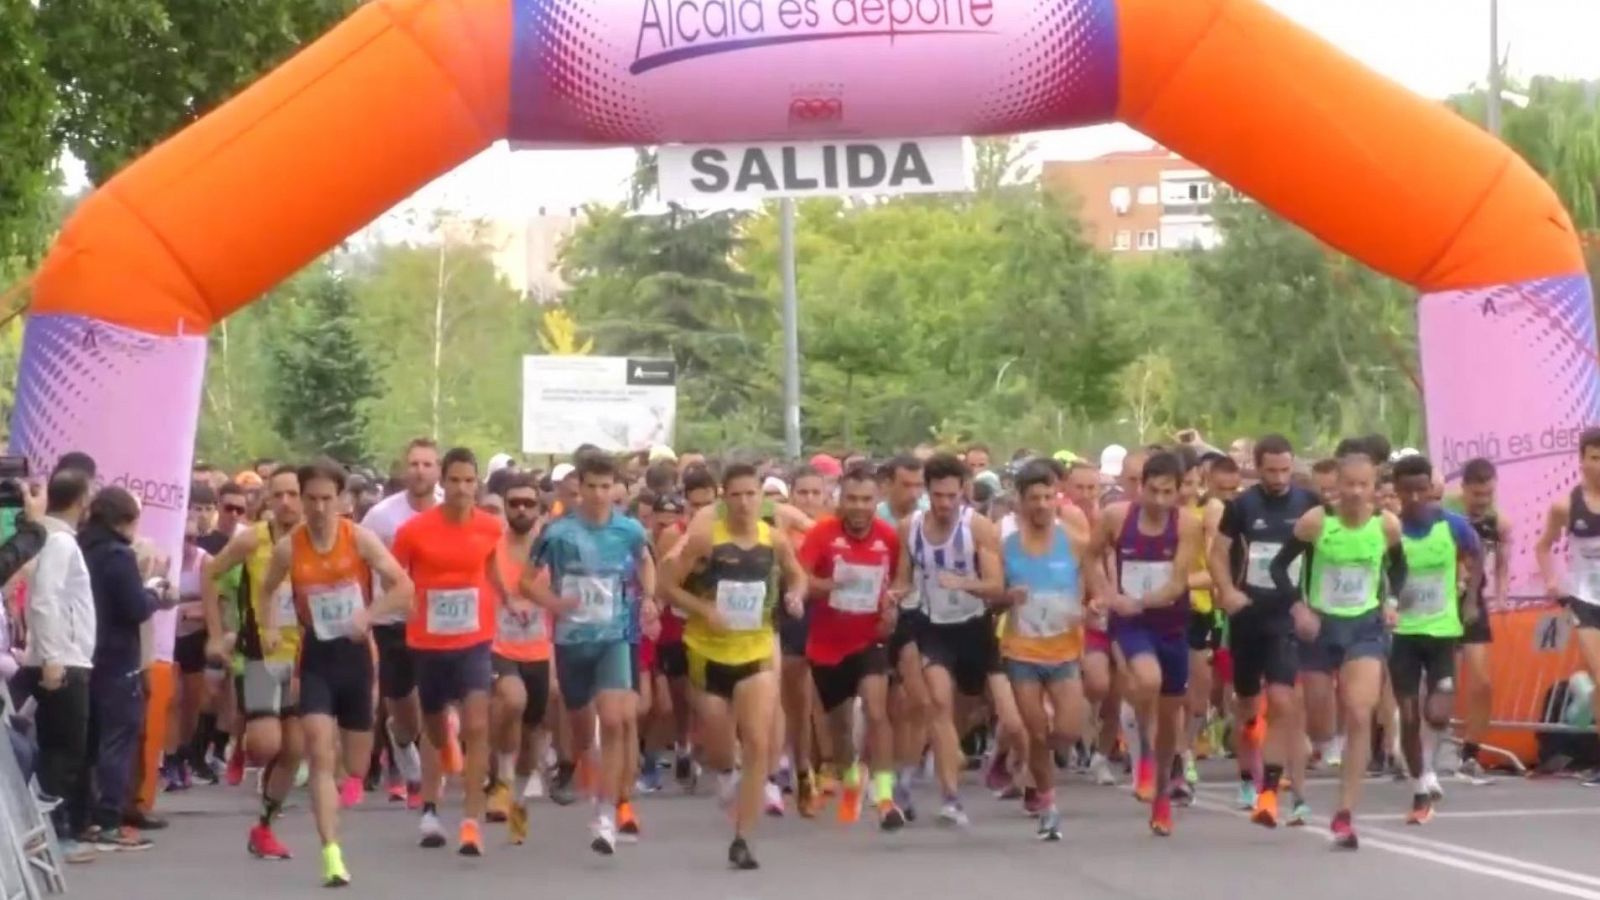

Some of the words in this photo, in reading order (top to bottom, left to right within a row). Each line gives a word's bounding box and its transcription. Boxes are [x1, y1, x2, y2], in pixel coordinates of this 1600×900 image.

[778, 0, 819, 29] es
[832, 0, 993, 46] deporte
[690, 142, 934, 194] SALIDA
[1508, 433, 1532, 455] es
